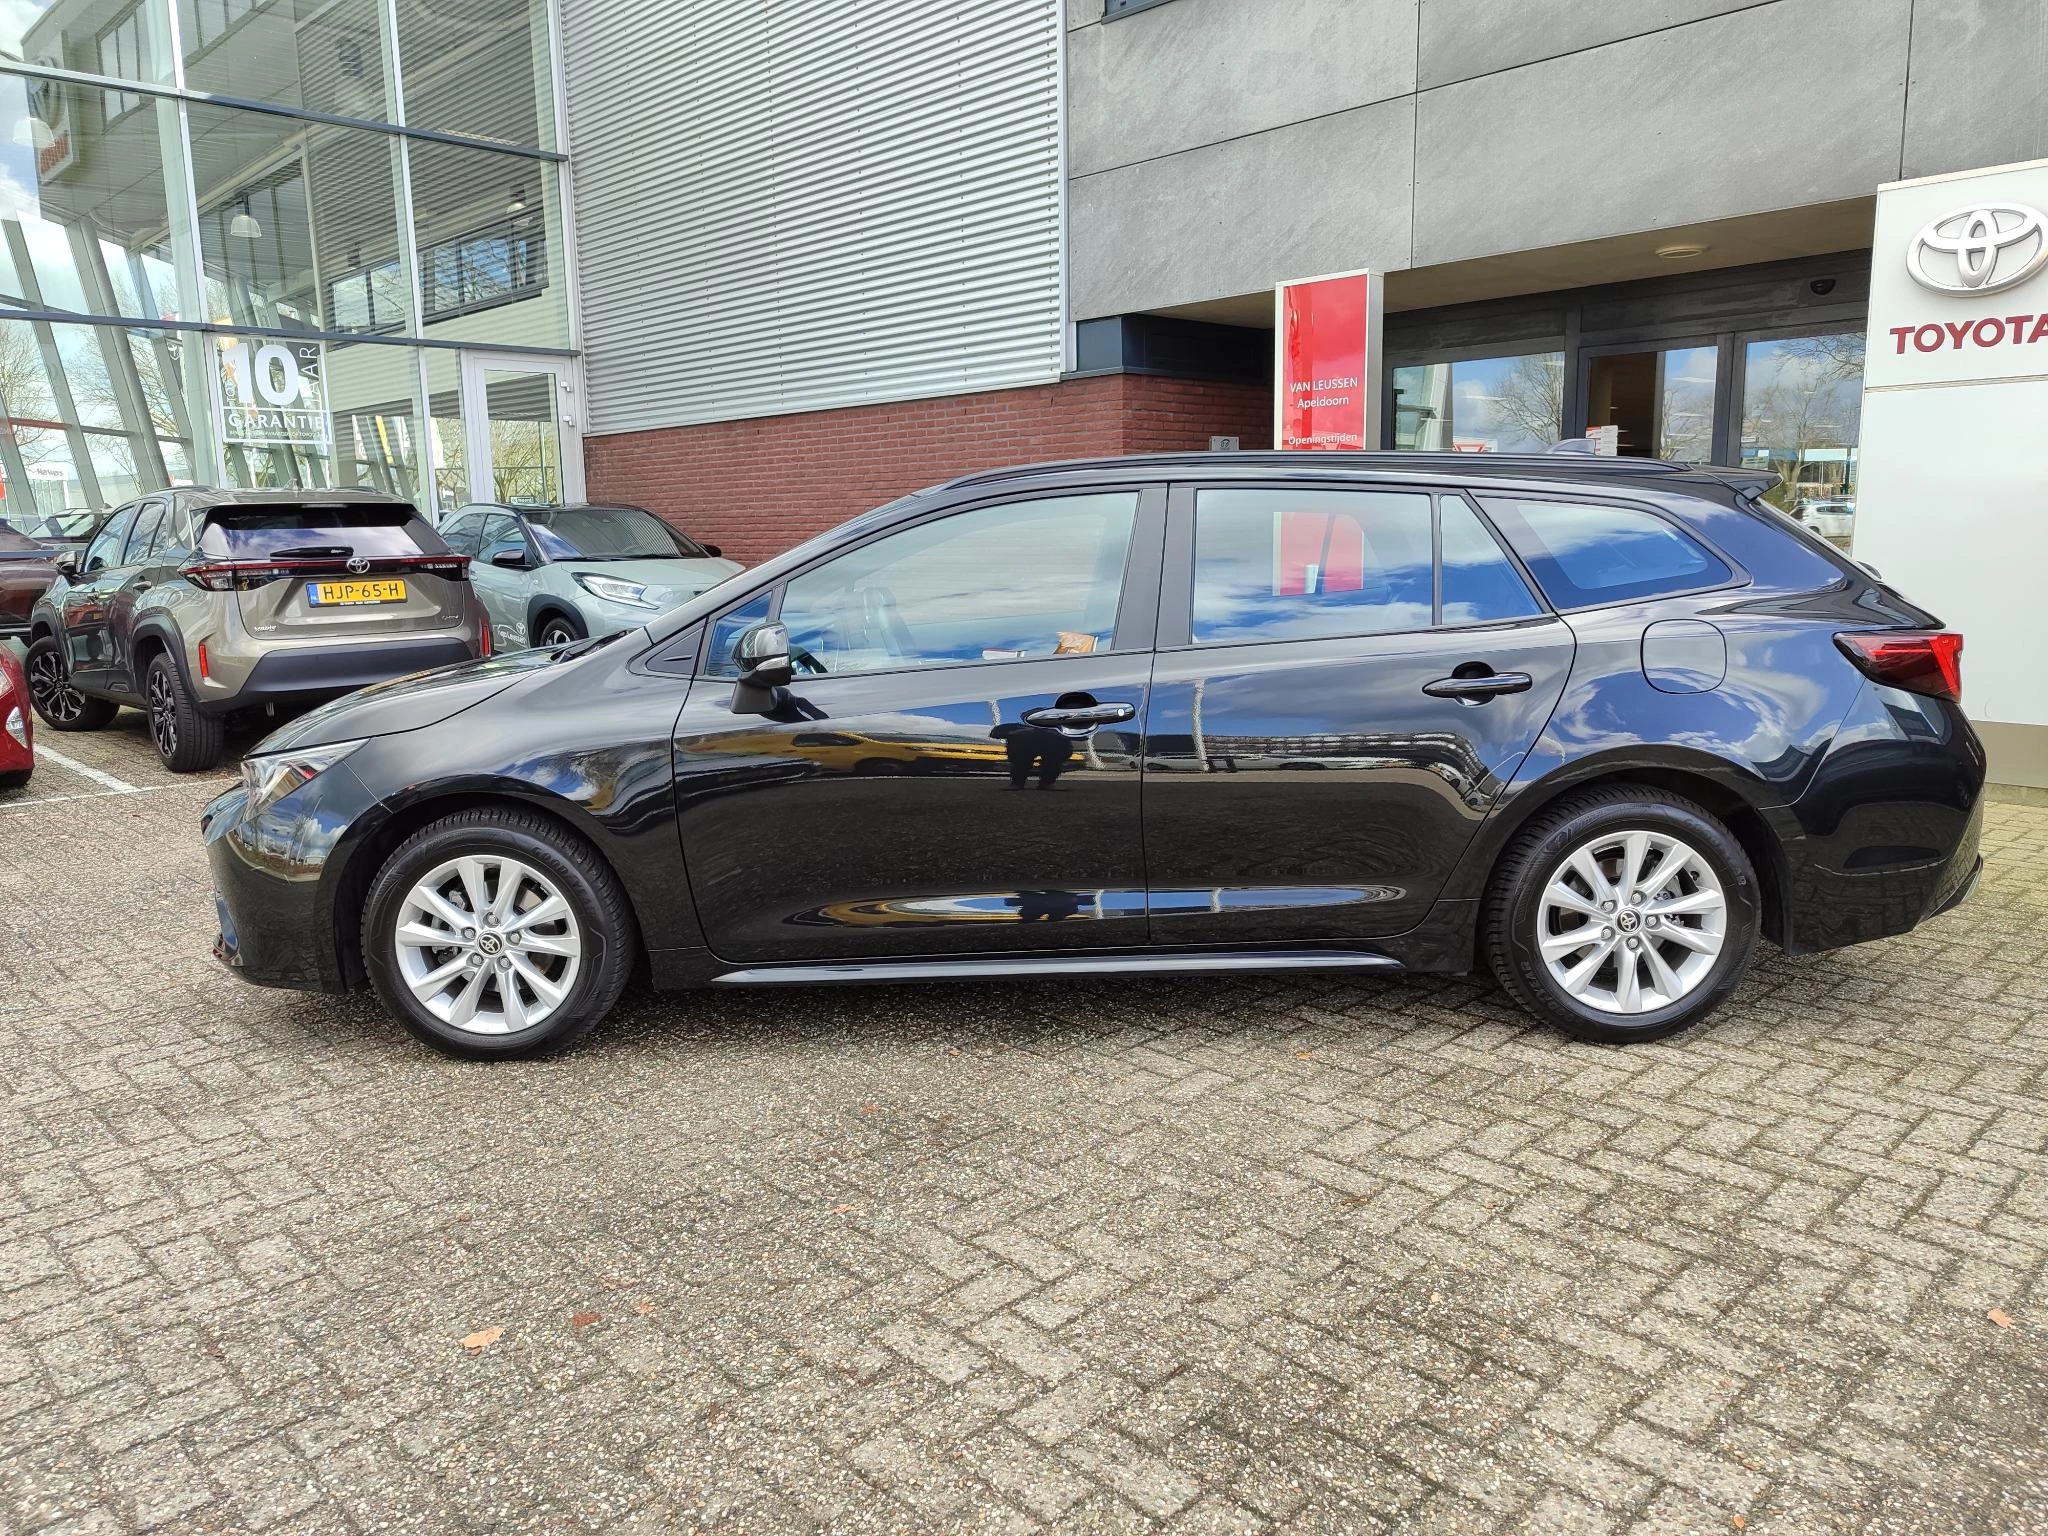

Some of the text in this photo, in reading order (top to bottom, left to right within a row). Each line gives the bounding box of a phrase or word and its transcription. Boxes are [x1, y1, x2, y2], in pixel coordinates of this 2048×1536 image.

[1889, 313, 2048, 355] TOYOTA
[222, 342, 300, 406] 10
[1289, 376, 1358, 393] VAN LEUSSEN
[1297, 396, 1349, 411] Apeldoorn
[228, 413, 322, 430] GARANTIE
[1288, 433, 1358, 448] Openingstijden
[323, 583, 399, 600] HJP-65-H
